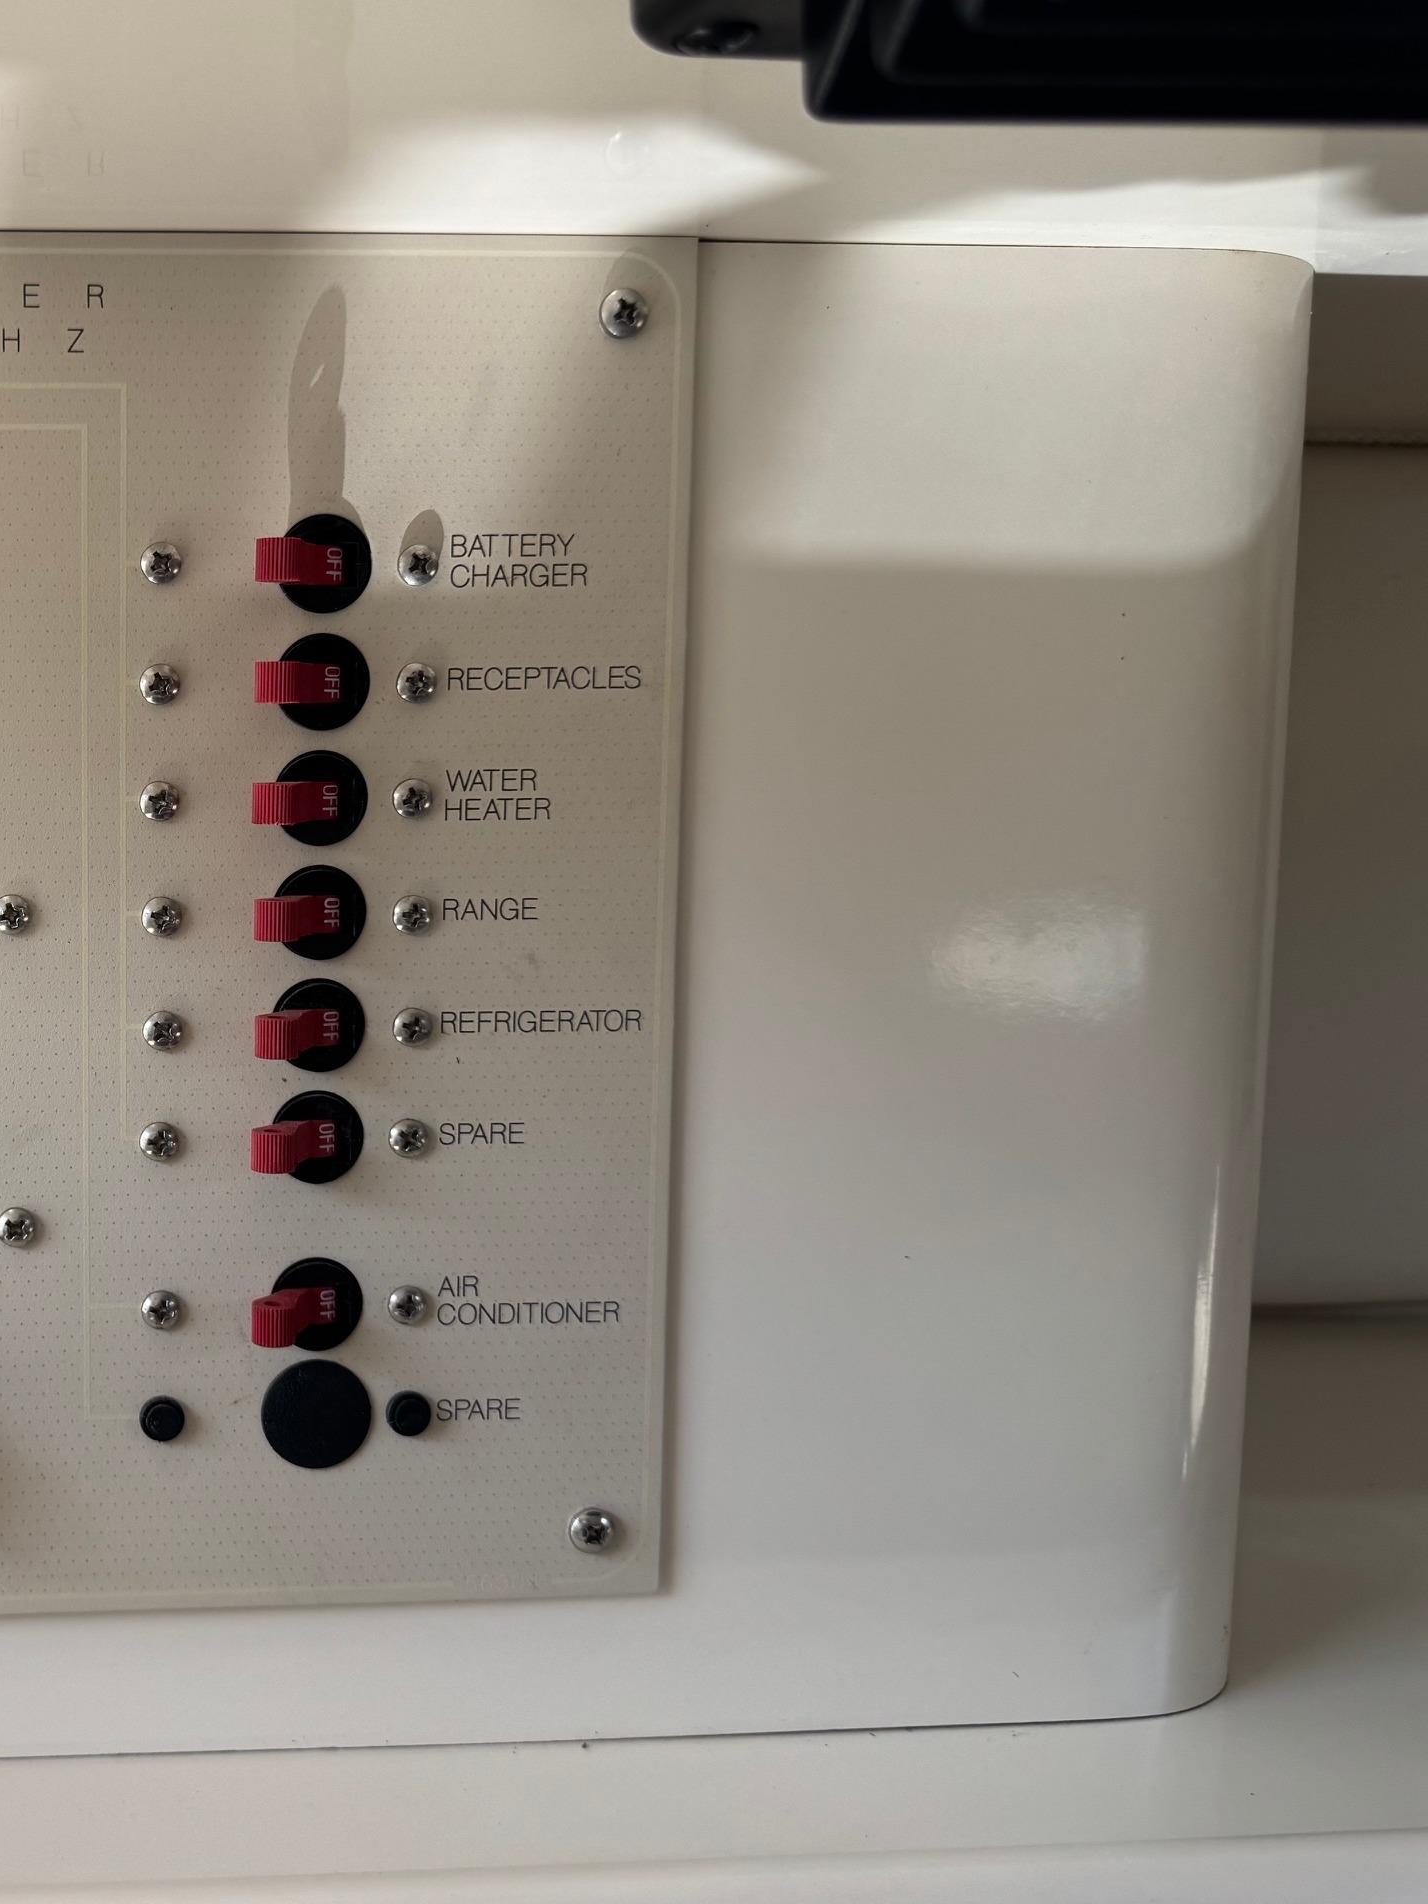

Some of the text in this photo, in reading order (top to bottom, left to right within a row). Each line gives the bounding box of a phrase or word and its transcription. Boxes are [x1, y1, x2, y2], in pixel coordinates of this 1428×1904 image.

[450, 533, 575, 559] BATTERY
[325, 547, 343, 581] OFF
[450, 563, 588, 589] CHARGER
[323, 666, 340, 699] OFF
[447, 665, 641, 691] RECEPTACLES
[445, 768, 537, 793] WATER
[322, 784, 338, 817] OFF
[444, 797, 551, 822] HEATER
[323, 897, 340, 928] OFF
[442, 897, 539, 921] RANGE
[322, 1011, 339, 1041] OFF
[440, 1009, 642, 1034] REFRIGERATOR
[318, 1123, 335, 1153] OFF
[438, 1122, 525, 1146] SPARE
[437, 1275, 479, 1298] AIR
[319, 1289, 336, 1319] OFF
[436, 1300, 620, 1326] CONDITIONER
[436, 1397, 521, 1422] SPARE
